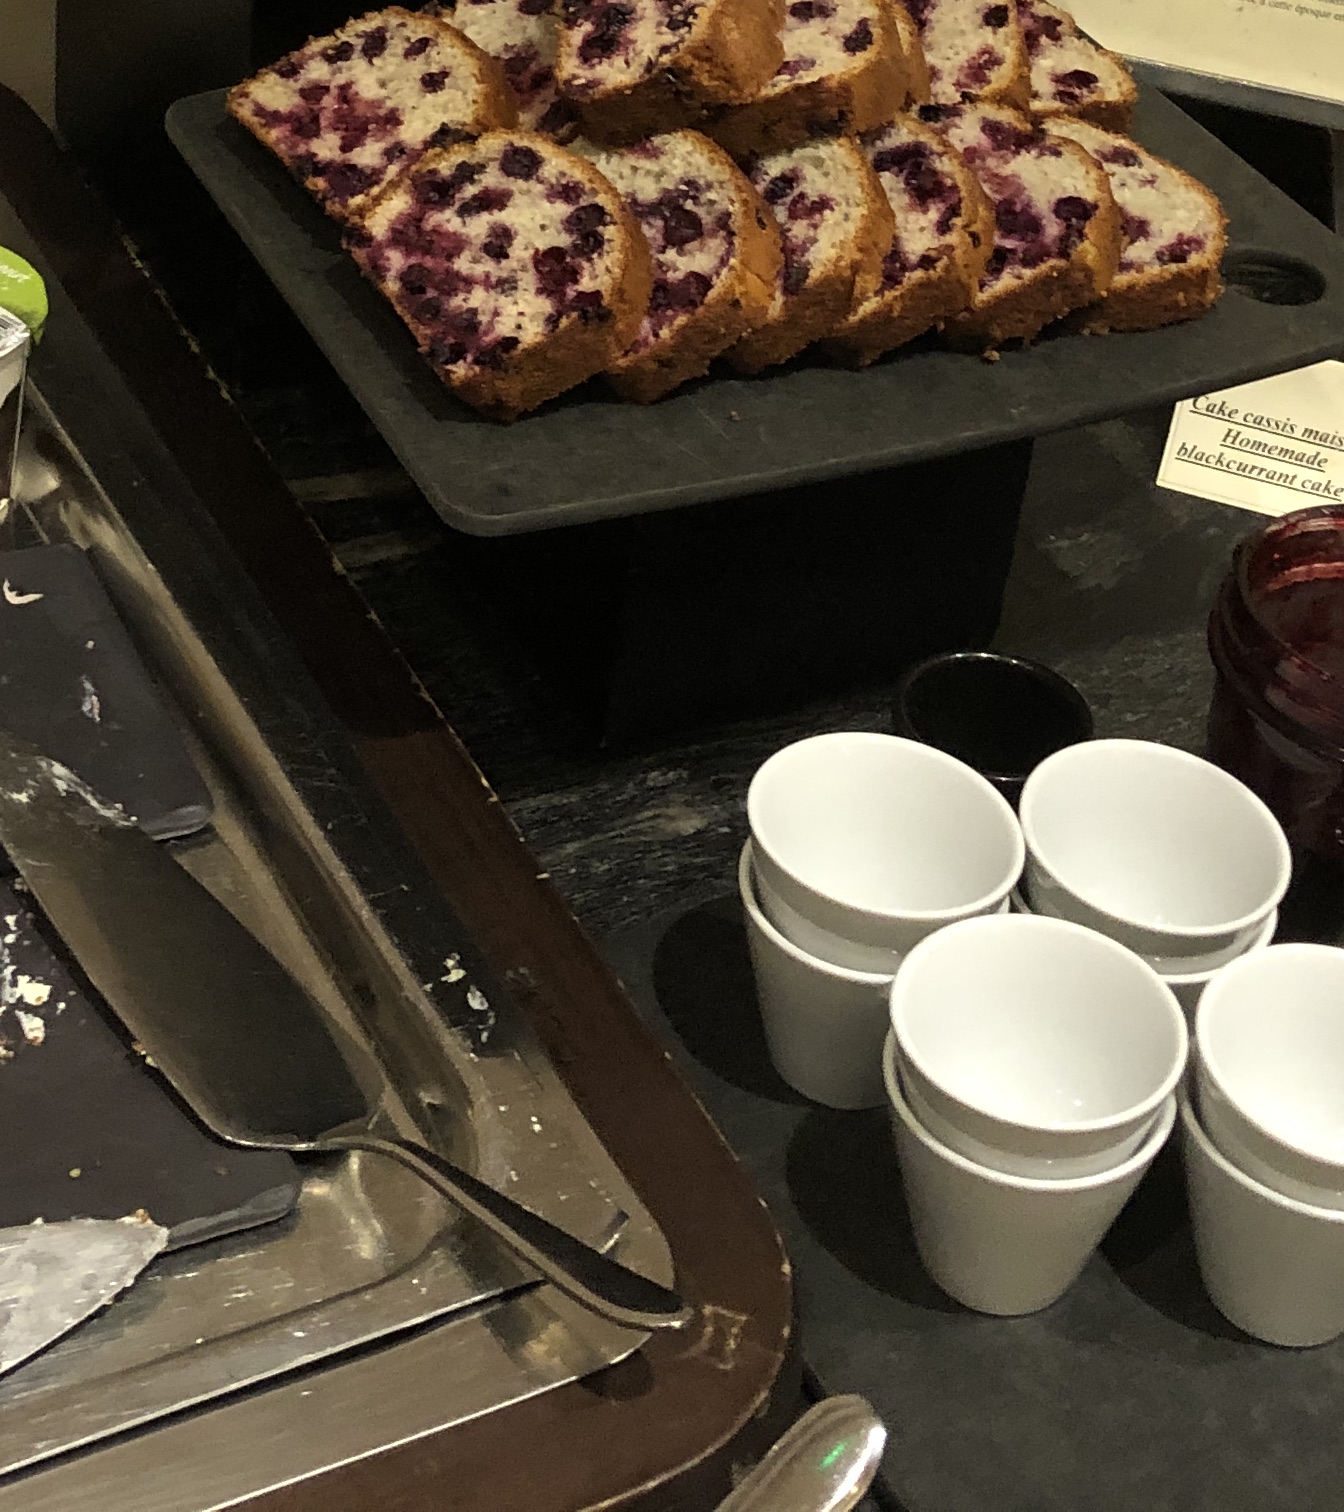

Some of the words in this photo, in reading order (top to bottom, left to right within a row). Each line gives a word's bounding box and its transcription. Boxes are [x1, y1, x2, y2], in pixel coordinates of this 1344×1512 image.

[1191, 395, 1239, 419] Cake
[1242, 415, 1298, 434] cassis
[1221, 427, 1329, 468] Homemade
[1176, 442, 1299, 486] blackcurrant
[1300, 478, 1344, 498] cake
